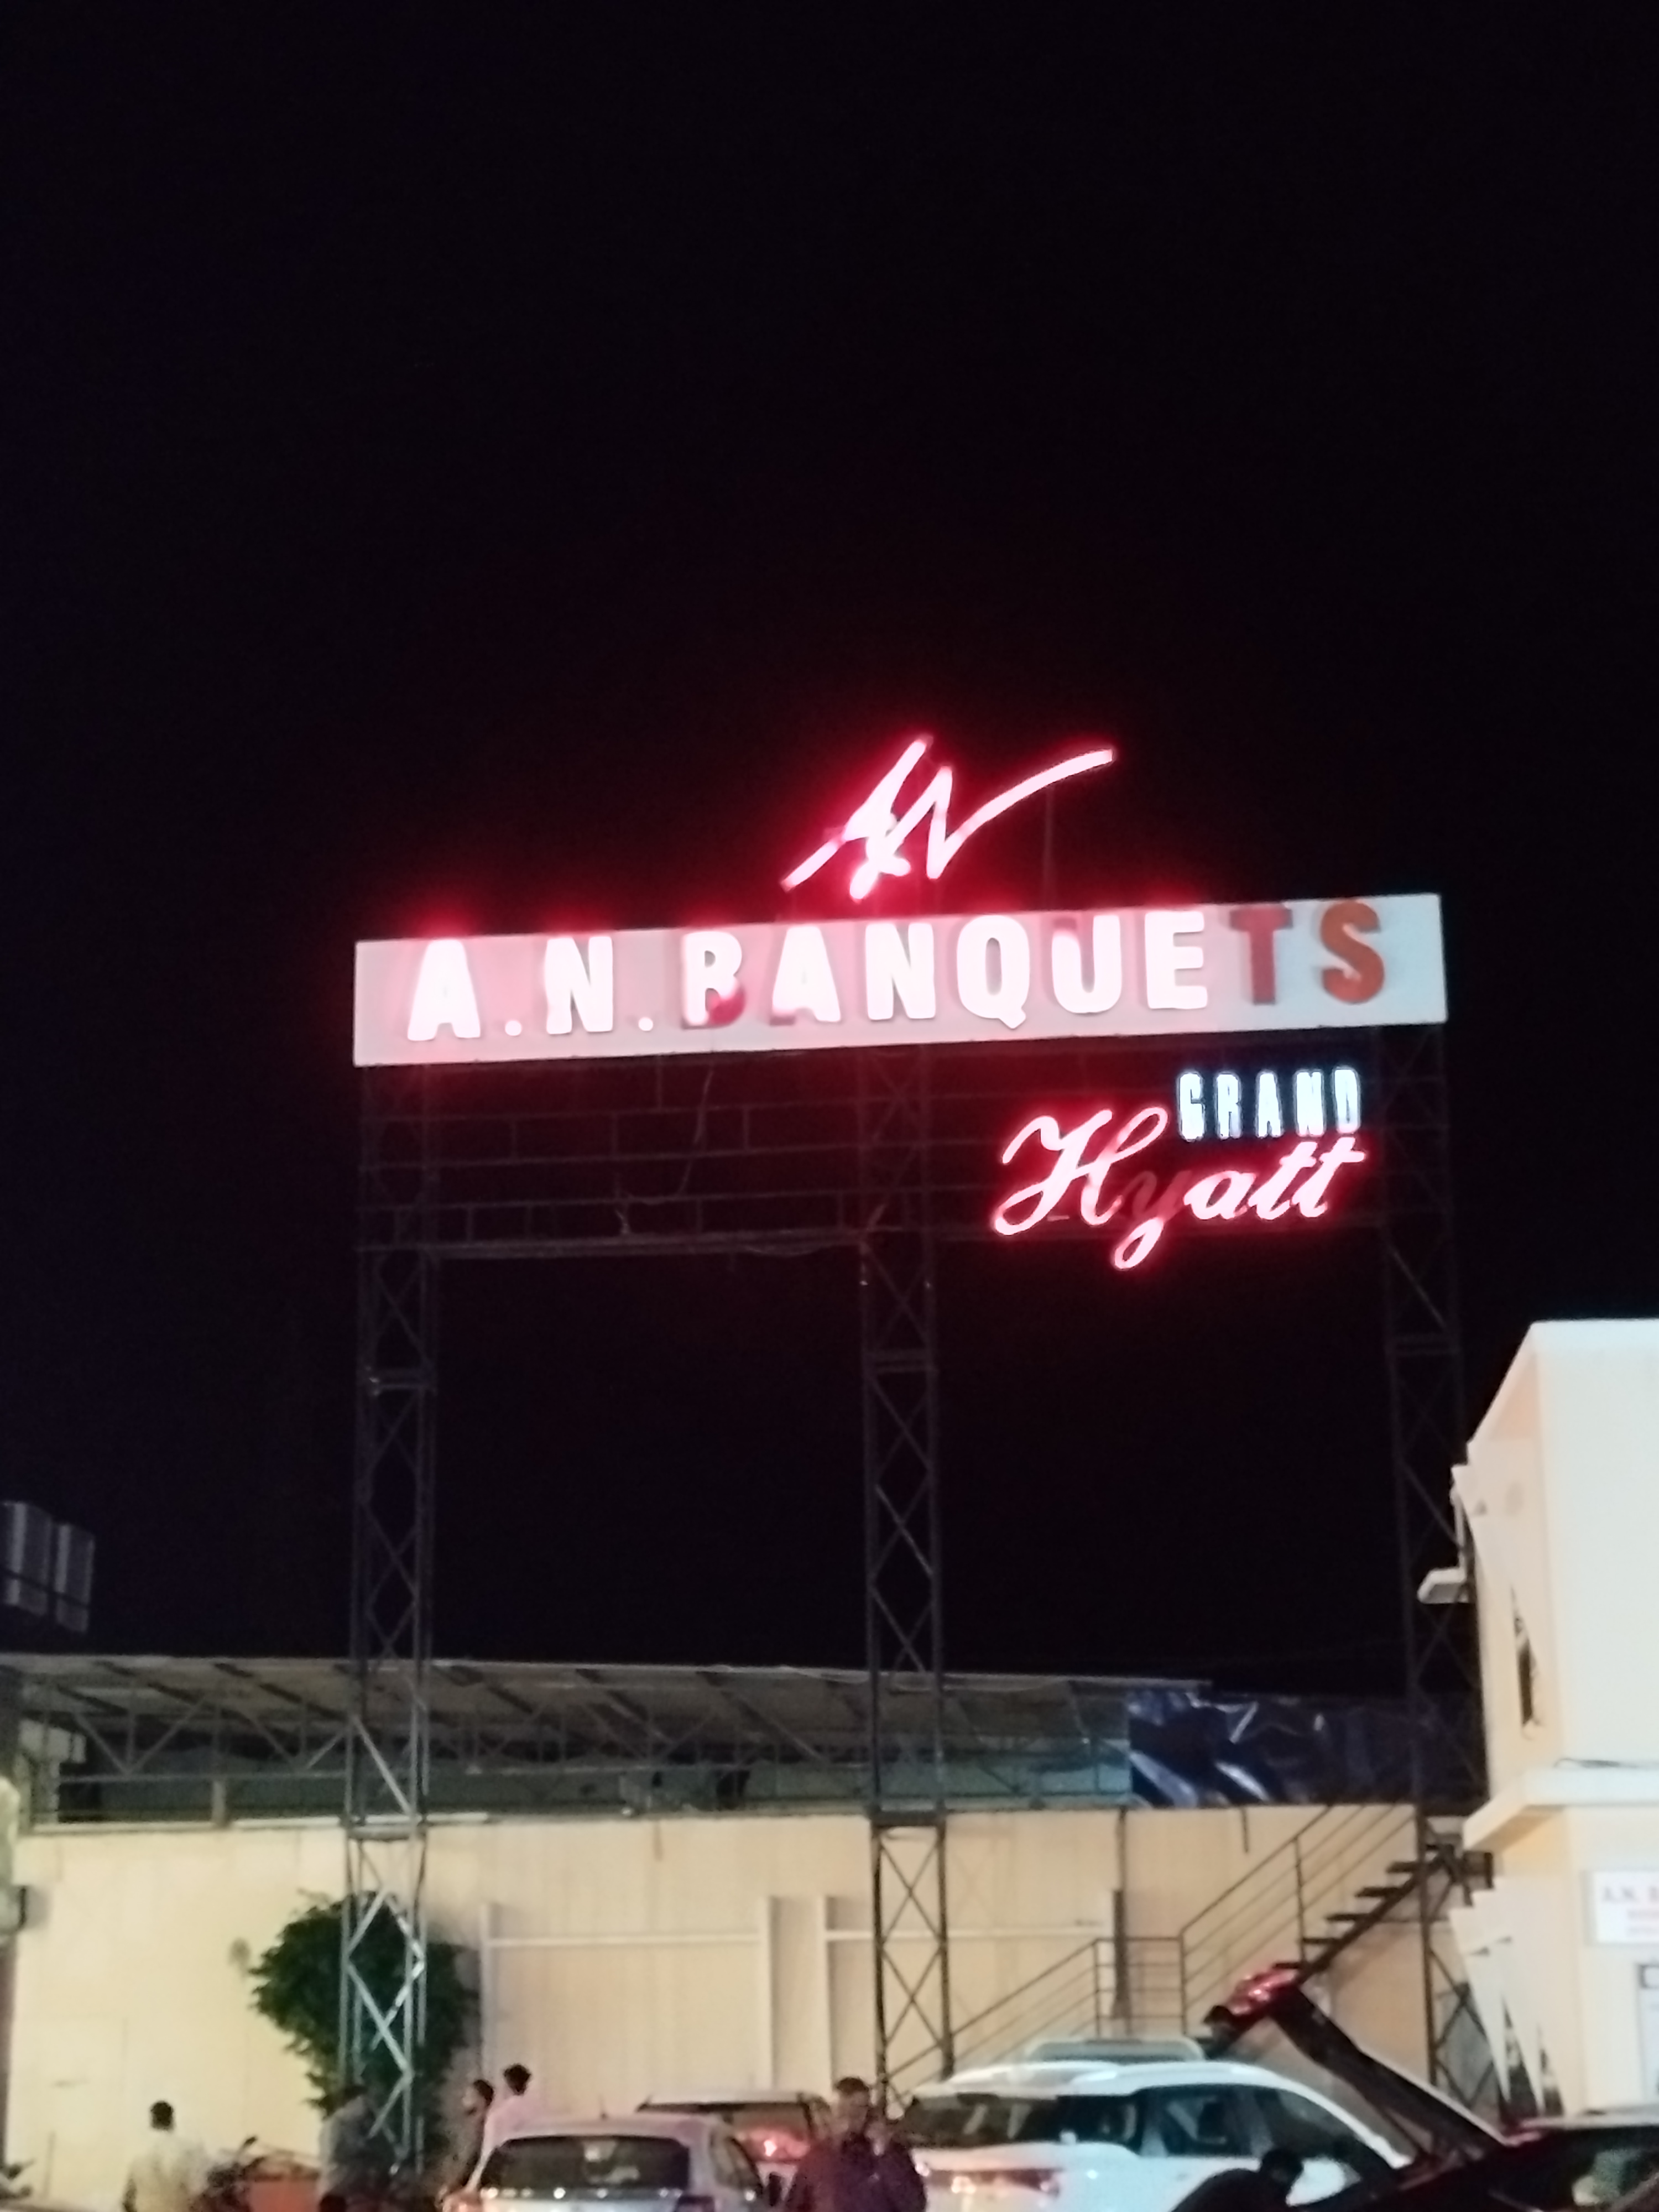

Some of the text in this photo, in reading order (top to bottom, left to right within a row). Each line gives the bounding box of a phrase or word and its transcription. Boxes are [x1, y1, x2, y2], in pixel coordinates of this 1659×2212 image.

[407, 897, 1386, 1041] A.N. BANQUETS
[1177, 1067, 1360, 1141] GRAND
[994, 1106, 1367, 1270] Hyatt
